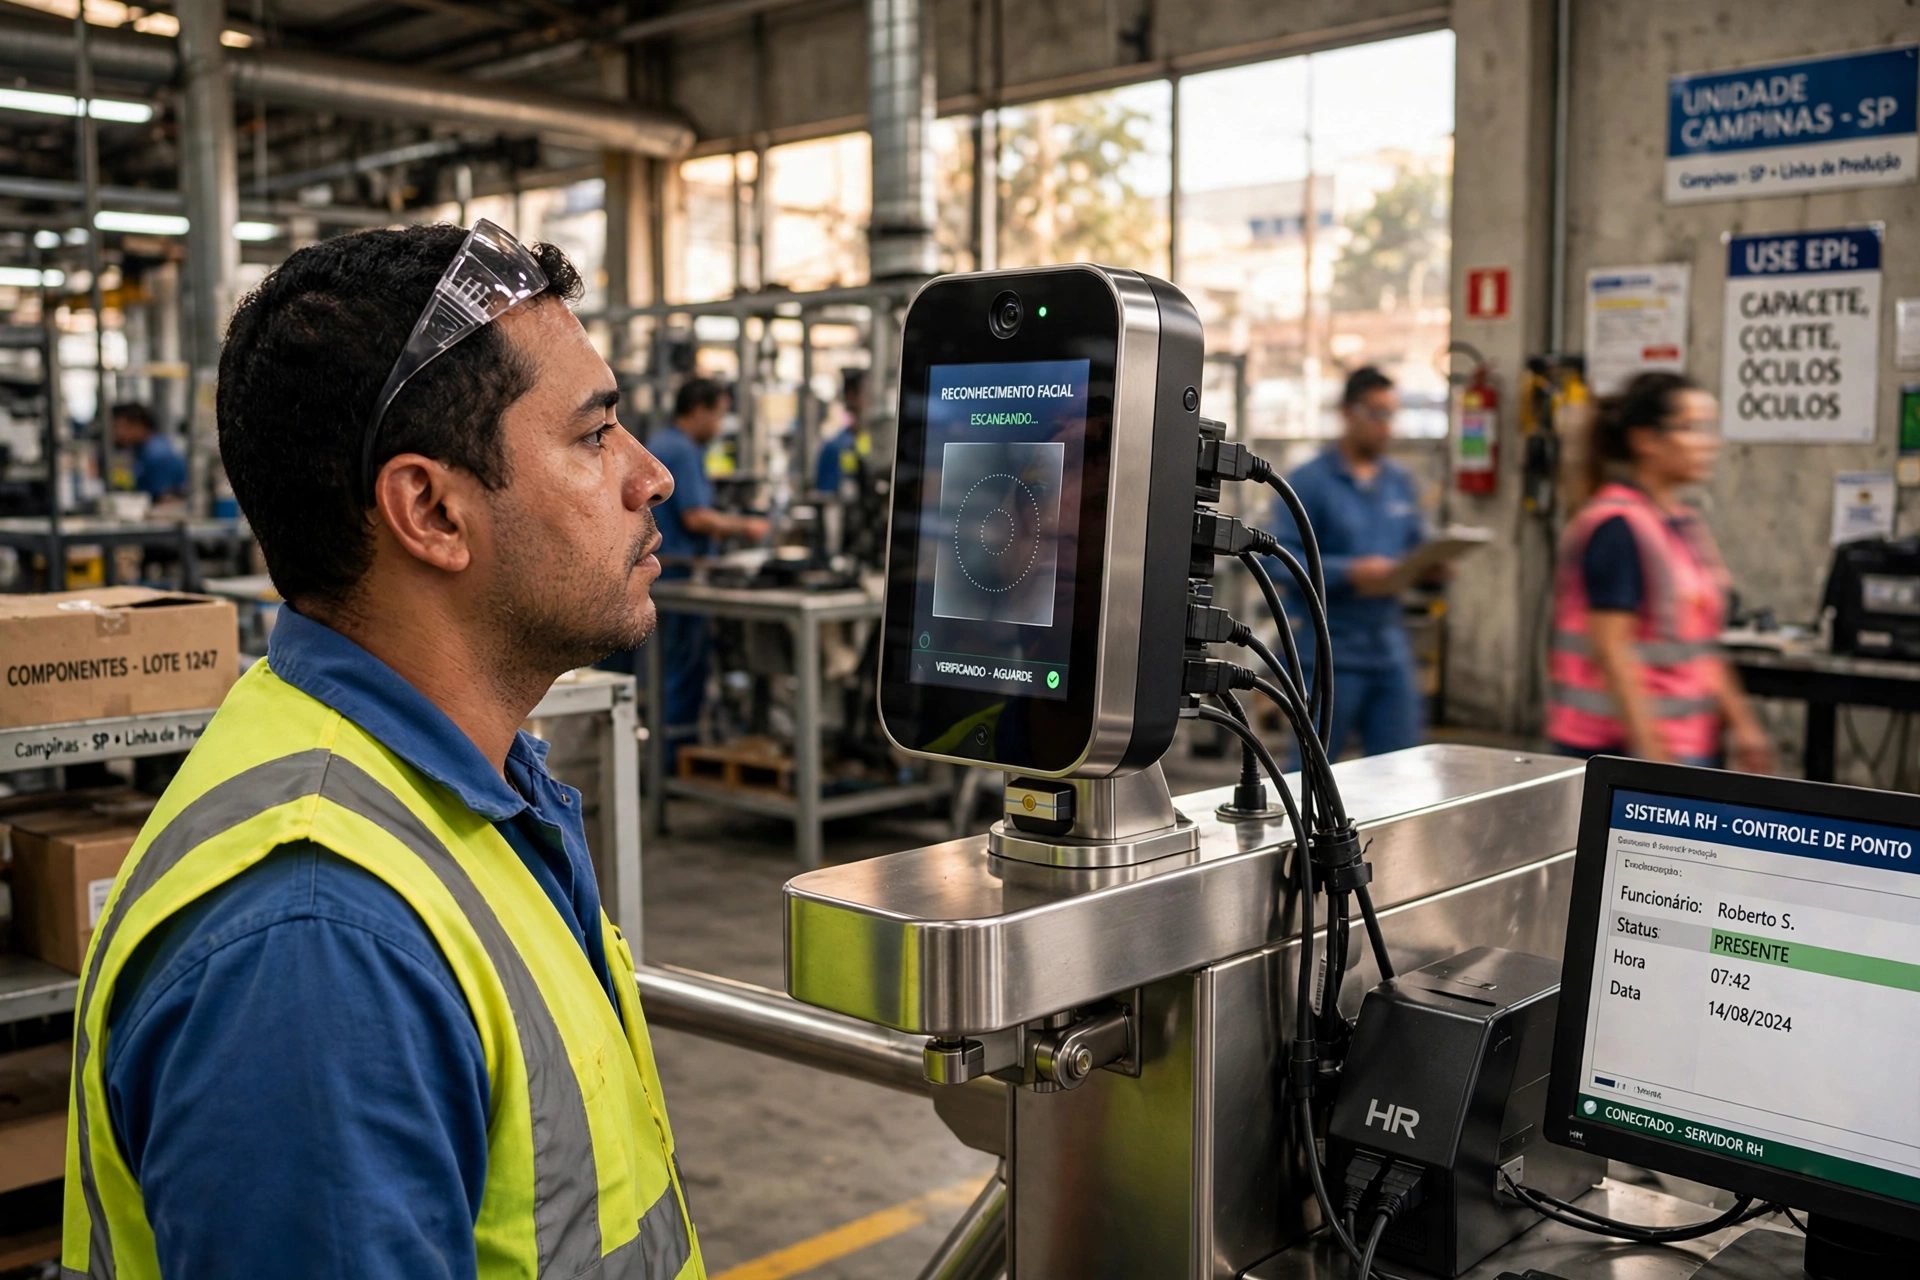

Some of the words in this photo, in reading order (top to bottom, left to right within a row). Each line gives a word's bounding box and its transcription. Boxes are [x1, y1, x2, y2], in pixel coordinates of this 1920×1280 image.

[1681, 73, 1809, 116] UNIDADE
[1680, 103, 1834, 147] CAMPINAS
[1857, 96, 1898, 129] SP
[1745, 240, 1799, 272] USE
[1805, 237, 1859, 269] EPI:
[1740, 286, 1870, 319] CAPACETE,
[1739, 322, 1840, 354] COLETE,
[941, 384, 1035, 400] RECONHECIMENTO
[1037, 383, 1075, 398] FACIAL
[970, 412, 1039, 425] ESCANEANDO...
[7, 657, 128, 686] COMPONENTES
[143, 653, 181, 675] LOTE
[186, 650, 218, 671] 1247
[935, 661, 986, 677] VERIFICANDO
[993, 667, 1033, 683] AGUARDE
[15, 737, 79, 760] Campinas
[92, 732, 109, 751] SP
[125, 728, 158, 746] Linha
[160, 725, 175, 742] de
[1625, 803, 1691, 828] SISTEMA
[1695, 812, 1718, 831] RH
[1732, 818, 1820, 846] CONTROLE
[1824, 830, 1846, 850] DE
[1851, 835, 1912, 859] PONTO
[1620, 885, 1702, 914] Funcionário:
[1718, 902, 1777, 927] Roberto
[1781, 913, 1795, 931] S.
[1714, 934, 1790, 963] PRESENTE
[1613, 948, 1646, 970] Hora
[1710, 968, 1751, 991] 07:42
[1610, 980, 1641, 1001] Data
[1708, 1001, 1793, 1033] 14/08/2024
[1365, 1099, 1420, 1139] HR
[1605, 1106, 1675, 1134] CONECTADO
[1684, 1126, 1743, 1152] SERVIDOR
[1746, 1142, 1764, 1157] RH
